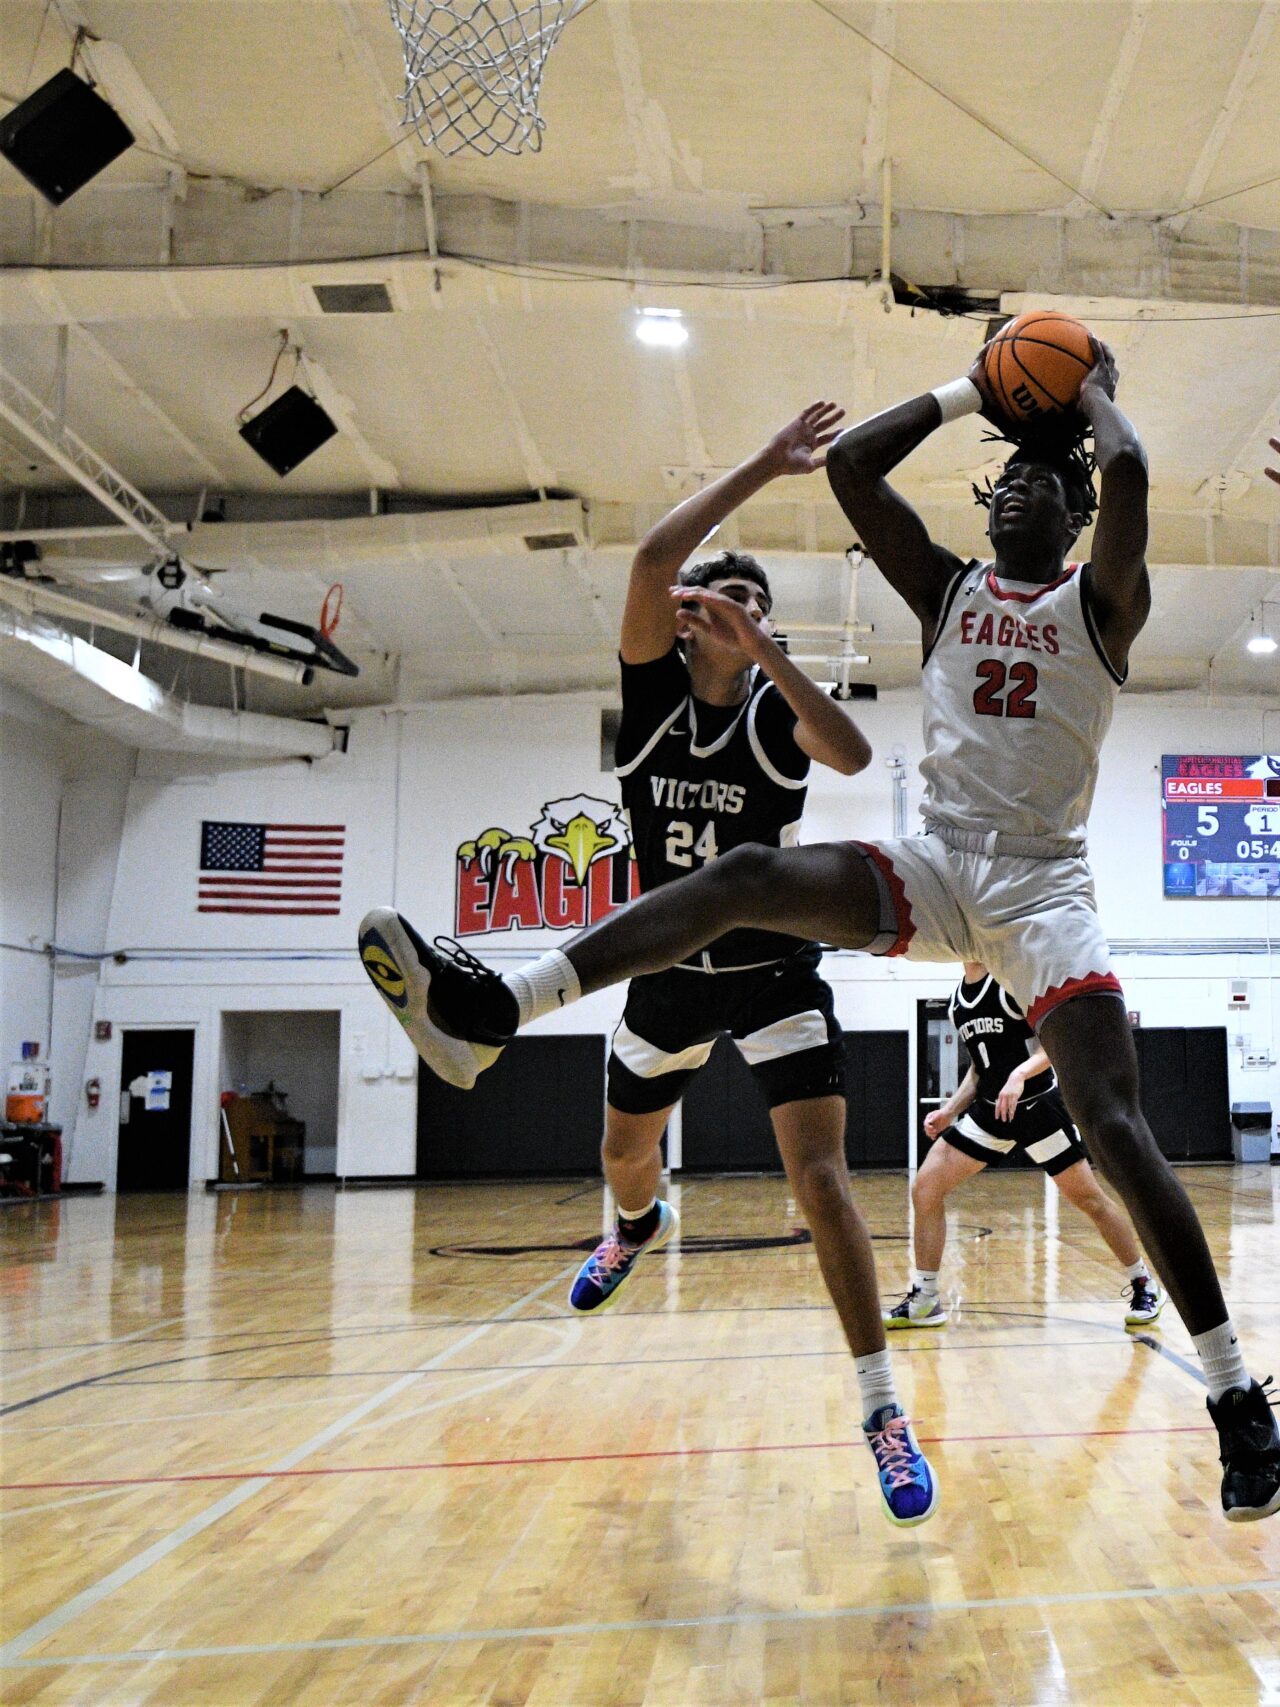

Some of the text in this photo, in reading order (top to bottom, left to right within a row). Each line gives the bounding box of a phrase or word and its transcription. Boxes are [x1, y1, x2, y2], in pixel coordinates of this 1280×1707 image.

[960, 610, 1061, 655] EAGLES
[973, 658, 1038, 719] 22
[650, 775, 747, 815] VICTORS
[1167, 783, 1223, 795] EAGLES
[1196, 805, 1220, 837] 5
[1259, 814, 1273, 833] 1
[665, 820, 719, 869] 24
[1178, 847, 1189, 860] 0
[977, 1041, 991, 1069] 1
